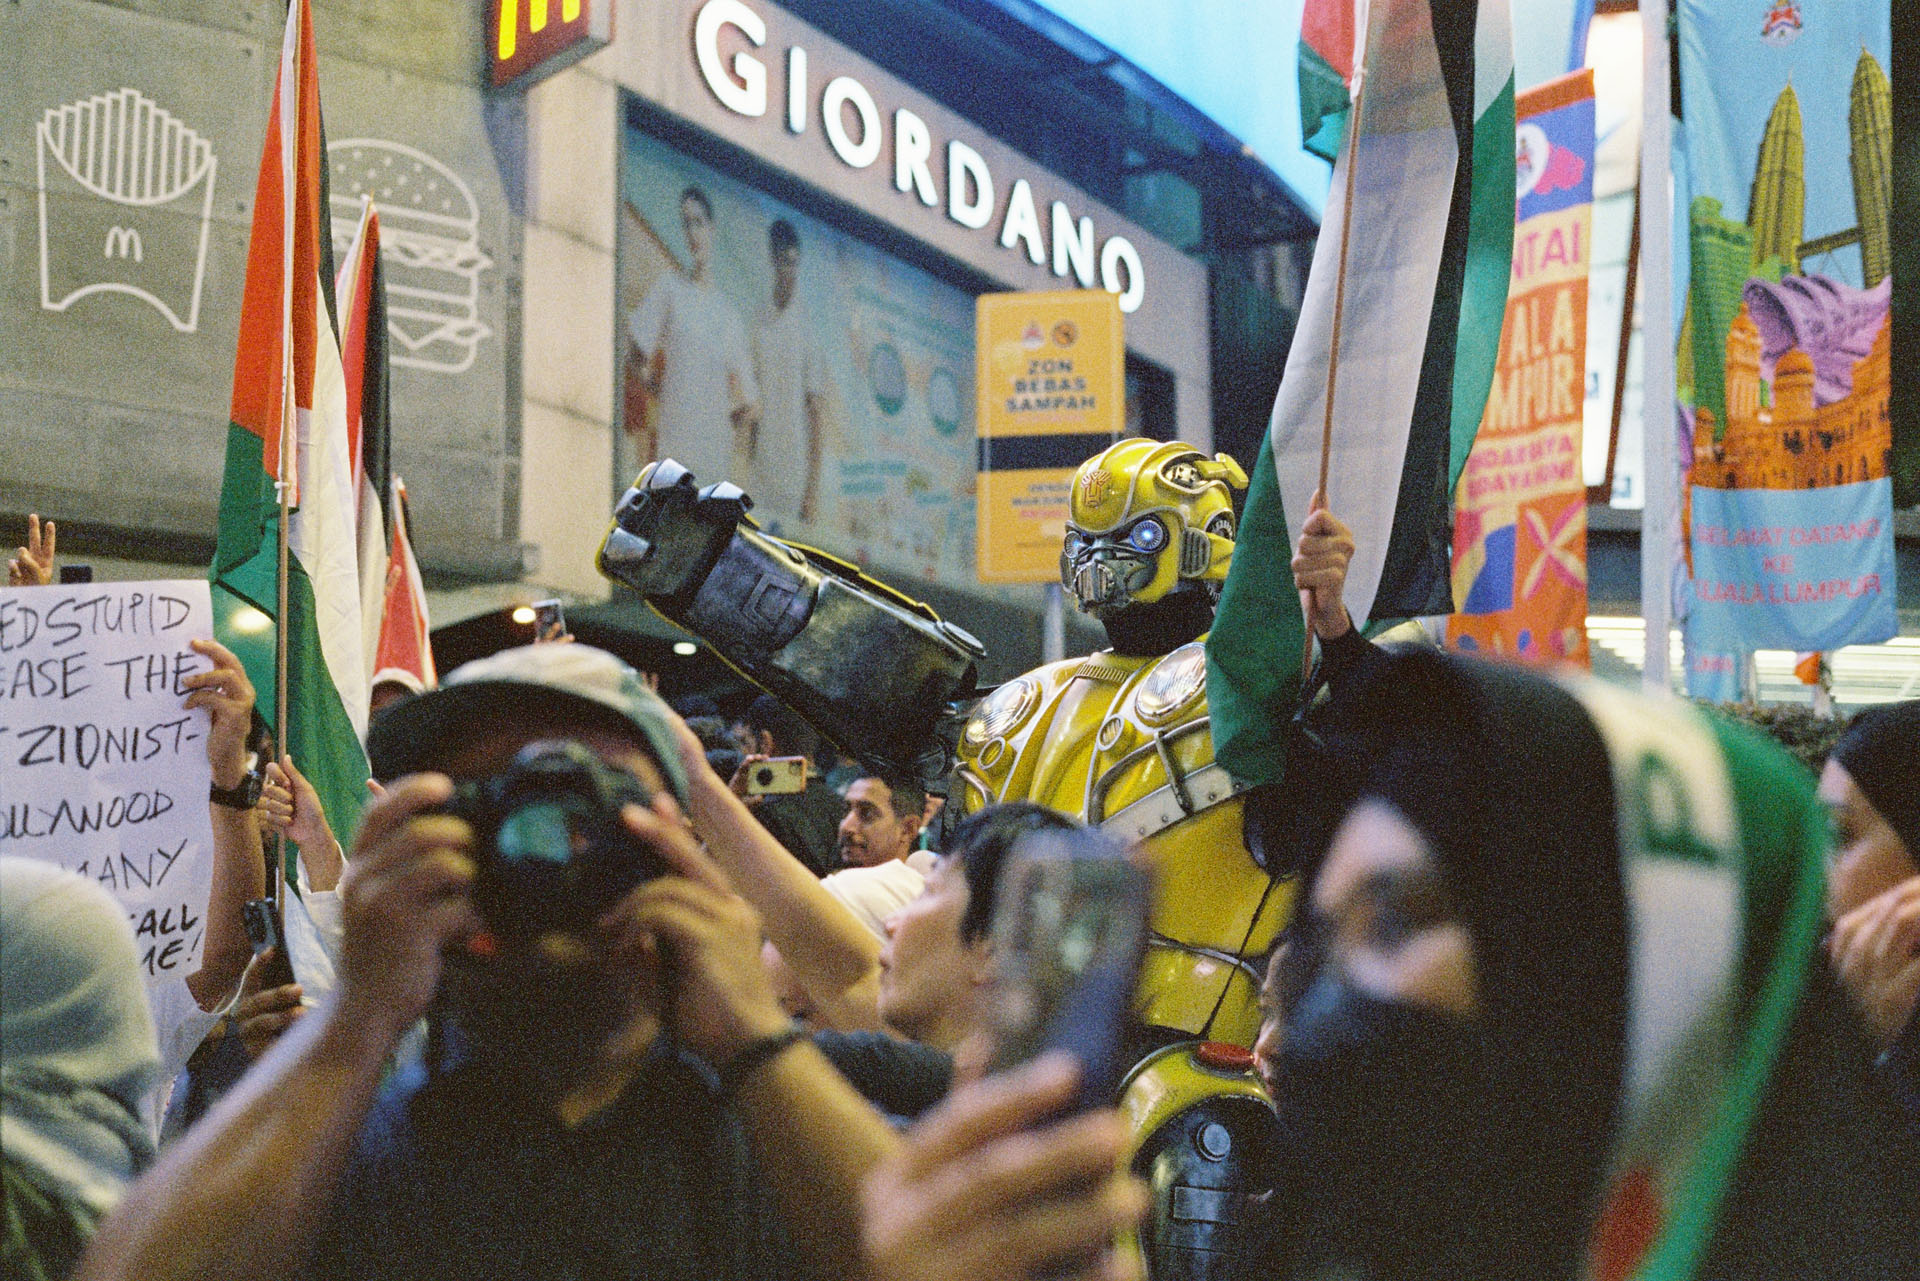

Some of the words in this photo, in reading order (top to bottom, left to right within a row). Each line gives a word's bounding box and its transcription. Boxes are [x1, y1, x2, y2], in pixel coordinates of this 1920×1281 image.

[695, 0, 1145, 313] GIORDANO
[1508, 288, 1577, 366] ALA
[1028, 359, 1073, 375] ZON
[1006, 396, 1095, 413] SAMPAH
[1762, 553, 1796, 575] KE
[1768, 572, 1881, 605] LUMPUR
[45, 592, 191, 647] STUPID
[104, 651, 207, 699] THE
[77, 838, 188, 891] ANY
[130, 903, 199, 939] ALL
